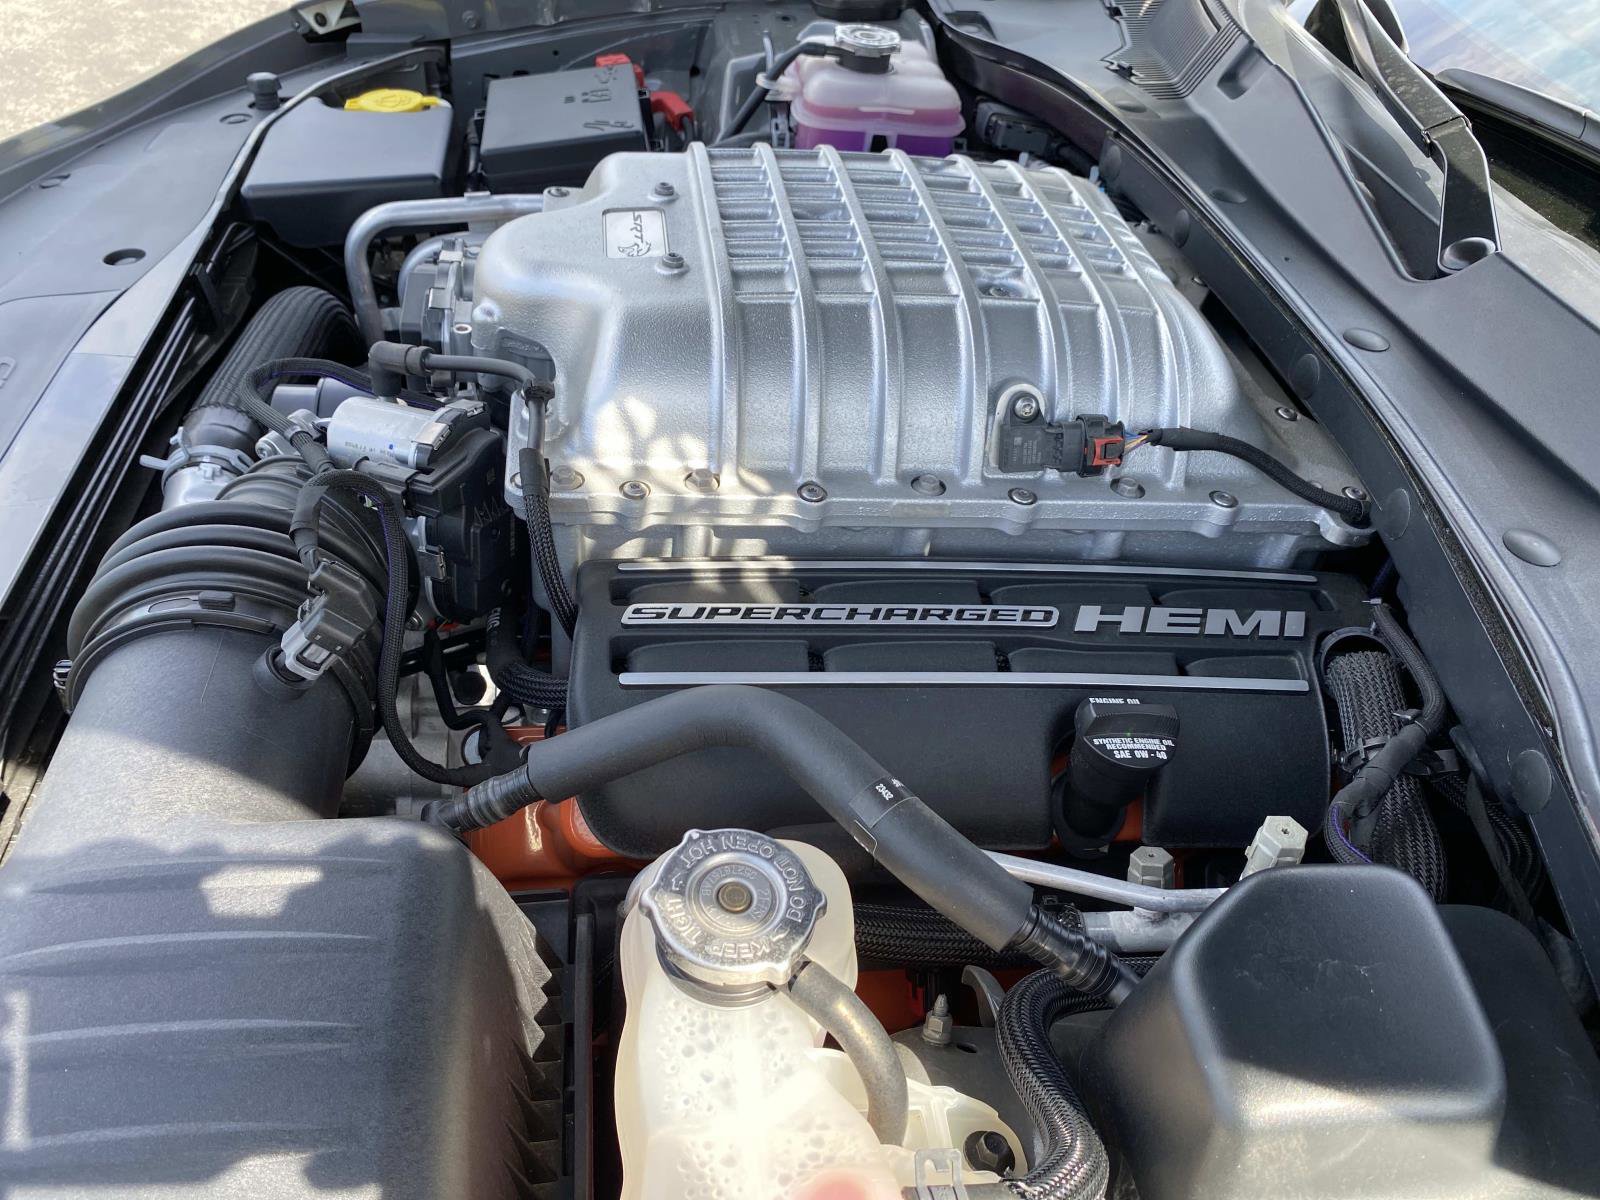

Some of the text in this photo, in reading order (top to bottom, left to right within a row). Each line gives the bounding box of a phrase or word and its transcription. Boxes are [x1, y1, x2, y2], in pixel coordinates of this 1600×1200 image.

[630, 211, 644, 243] SRT
[627, 604, 1306, 638] SUPERCHARGED HEMI
[1092, 737, 1175, 747] SYNTHETIC ENGINE OIL
[1106, 743, 1167, 751] RECOMMENDED
[1113, 750, 1132, 759] SAE
[680, 835, 808, 923] DO NOT OPEN HOT
[704, 940, 771, 959] KEEP
